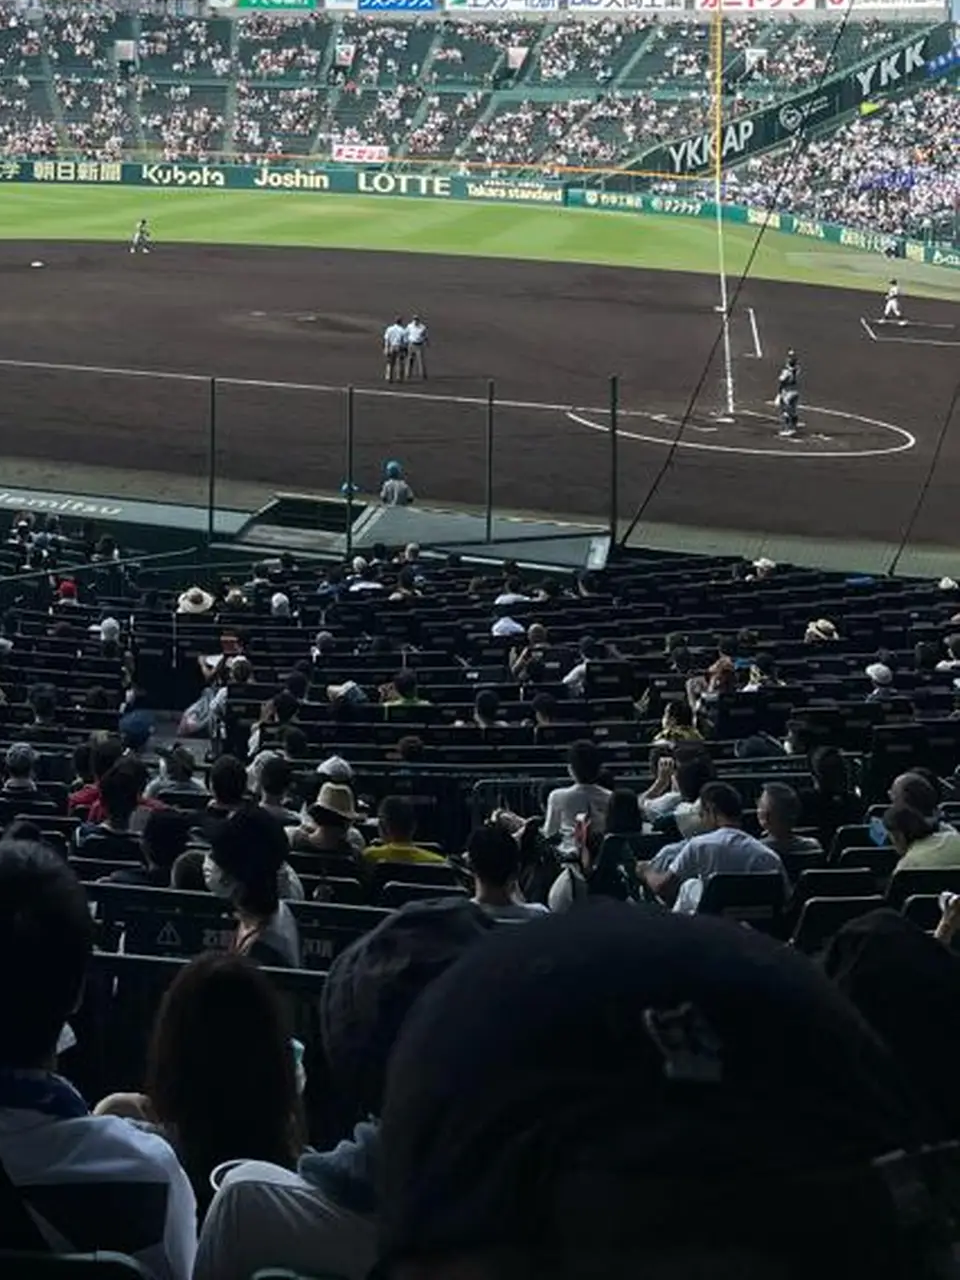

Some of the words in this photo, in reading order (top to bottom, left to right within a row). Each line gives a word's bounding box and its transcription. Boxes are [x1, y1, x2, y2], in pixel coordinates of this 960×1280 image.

[856, 39, 926, 96] YKK
[722, 120, 754, 157] AP
[33, 163, 122, 181] 朝日新聞
[142, 164, 225, 186] Kubota
[254, 168, 330, 189] Joshin
[357, 172, 451, 196] LOTTE
